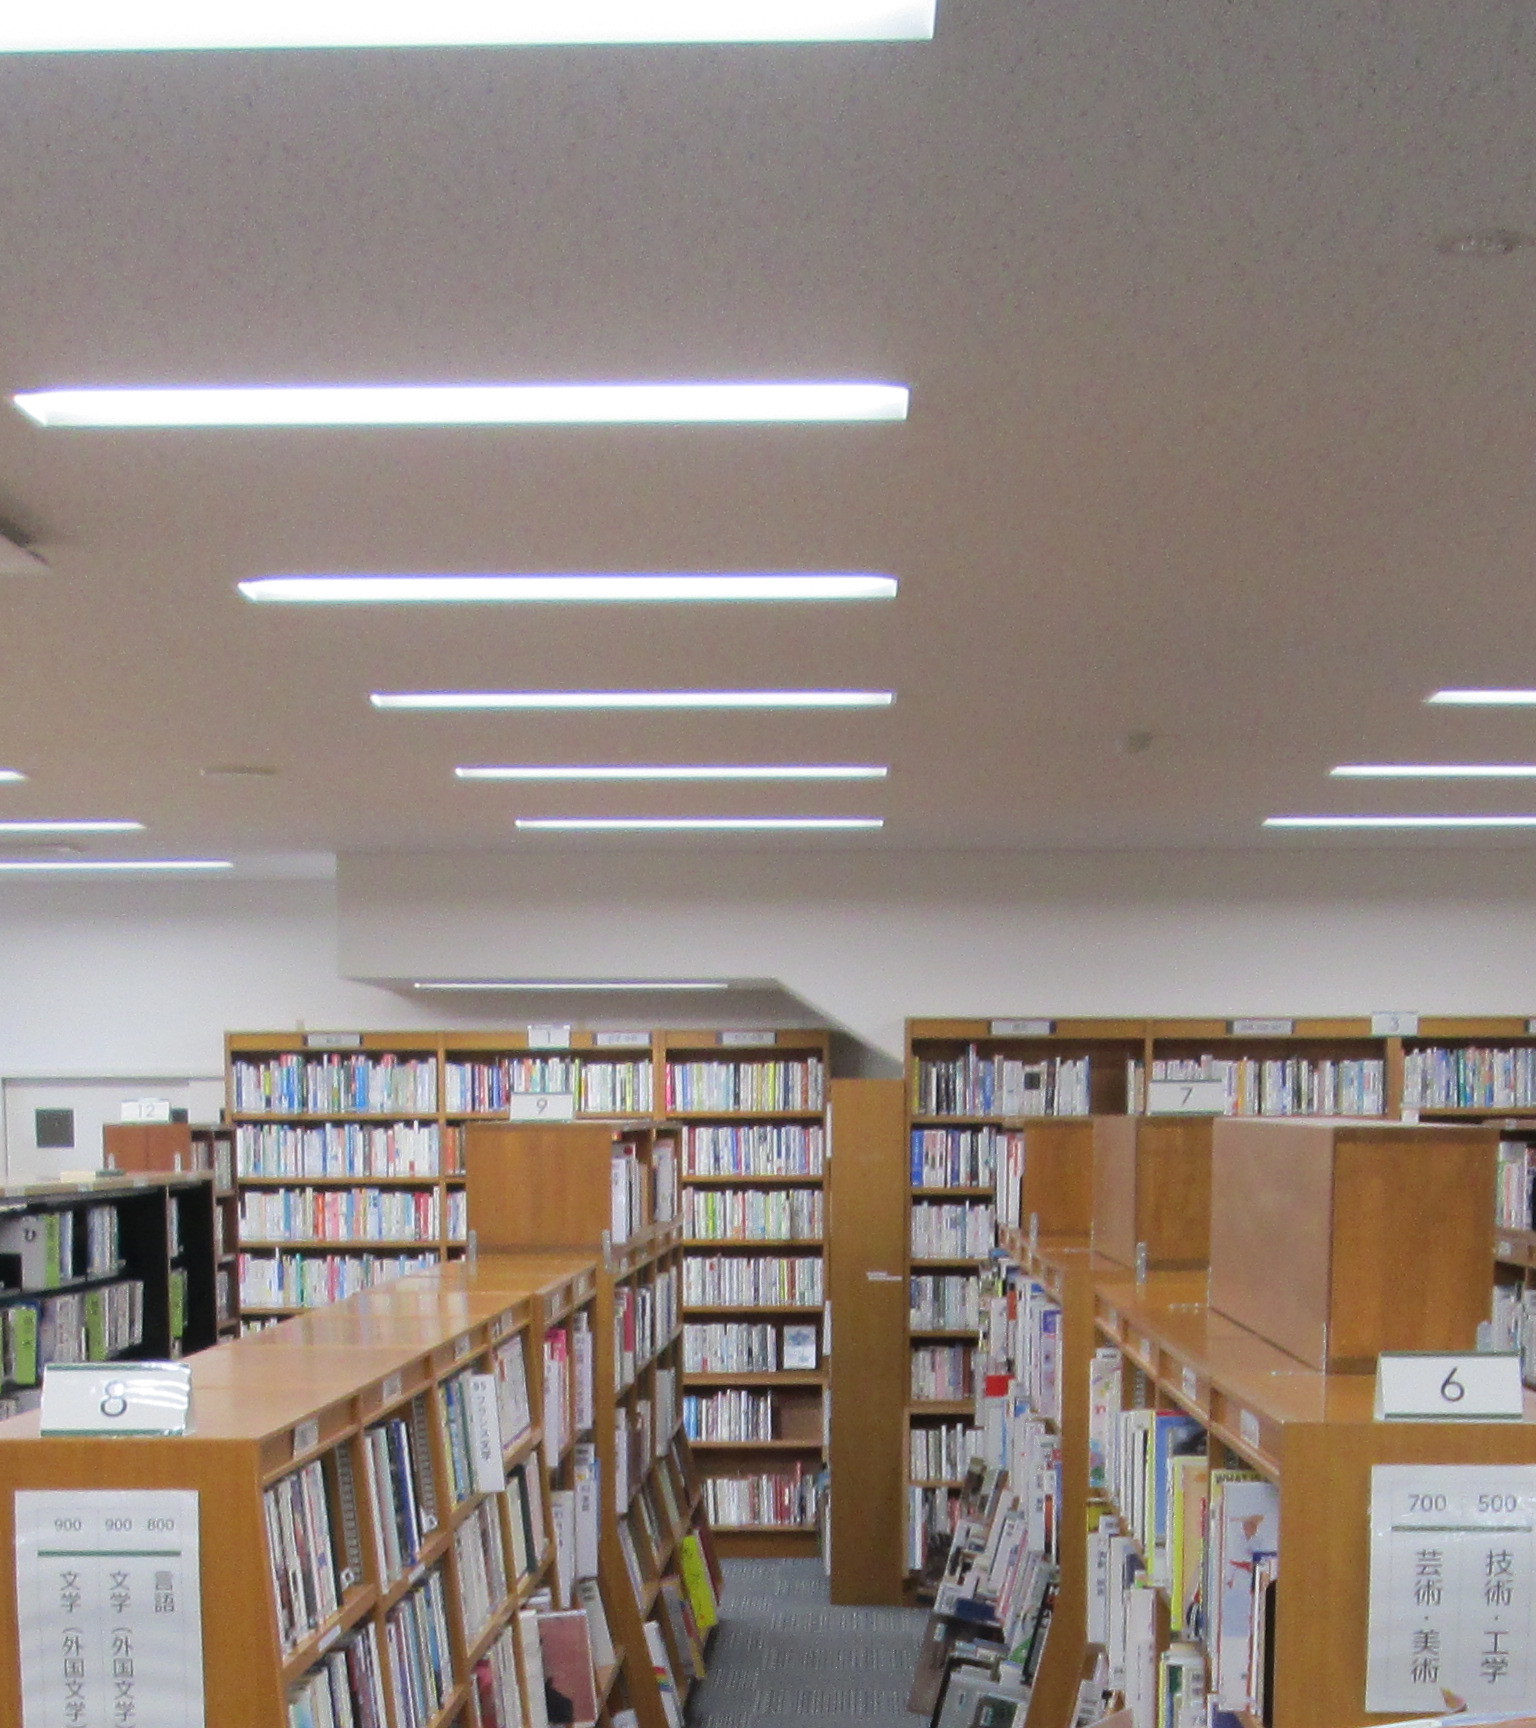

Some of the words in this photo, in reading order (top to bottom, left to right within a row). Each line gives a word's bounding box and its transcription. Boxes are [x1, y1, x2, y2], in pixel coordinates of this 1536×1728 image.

[1389, 1017, 1399, 1031] 3
[535, 1098, 547, 1114] 9
[1179, 1087, 1192, 1106] 7
[137, 1104, 155, 1118] 12
[1440, 1367, 1465, 1402] 6
[100, 1380, 128, 1417] 8
[1408, 1493, 1447, 1513] 700
[1478, 1493, 1518, 1513] 500
[54, 1518, 82, 1532] 900
[104, 1518, 132, 1532] 900
[147, 1518, 175, 1532] 800
[154, 1569, 176, 1614] 言語
[1412, 1549, 1443, 1684] 芸術・美術
[1480, 1549, 1514, 1684] 技術・工学
